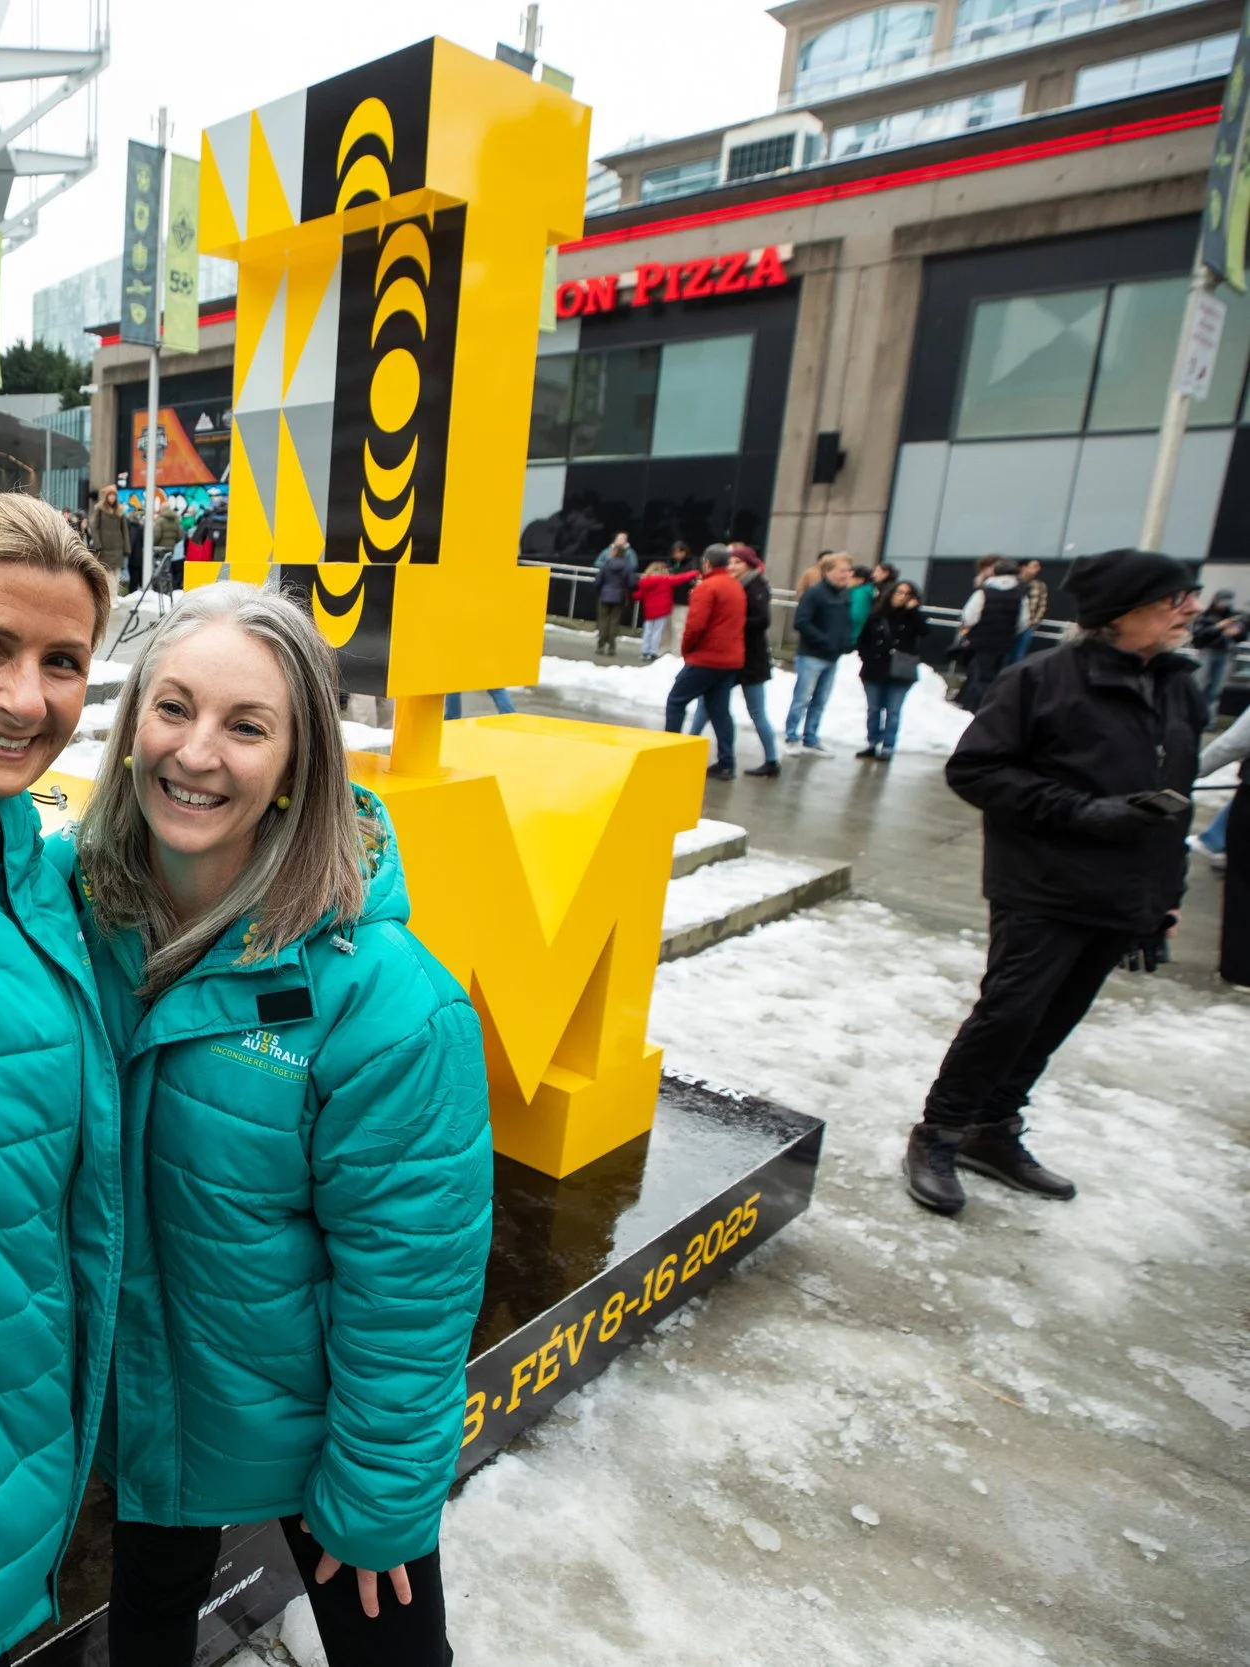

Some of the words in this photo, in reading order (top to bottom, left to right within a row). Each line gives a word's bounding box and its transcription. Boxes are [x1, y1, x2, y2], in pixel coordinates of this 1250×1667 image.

[630, 245, 789, 308] PIZZA
[210, 1044, 268, 1070] UNCONQUERED
[241, 1029, 281, 1045] CTUS
[505, 1309, 596, 1415] FÉV
[598, 1253, 679, 1343] 8-16
[681, 1192, 761, 1283] 2025
